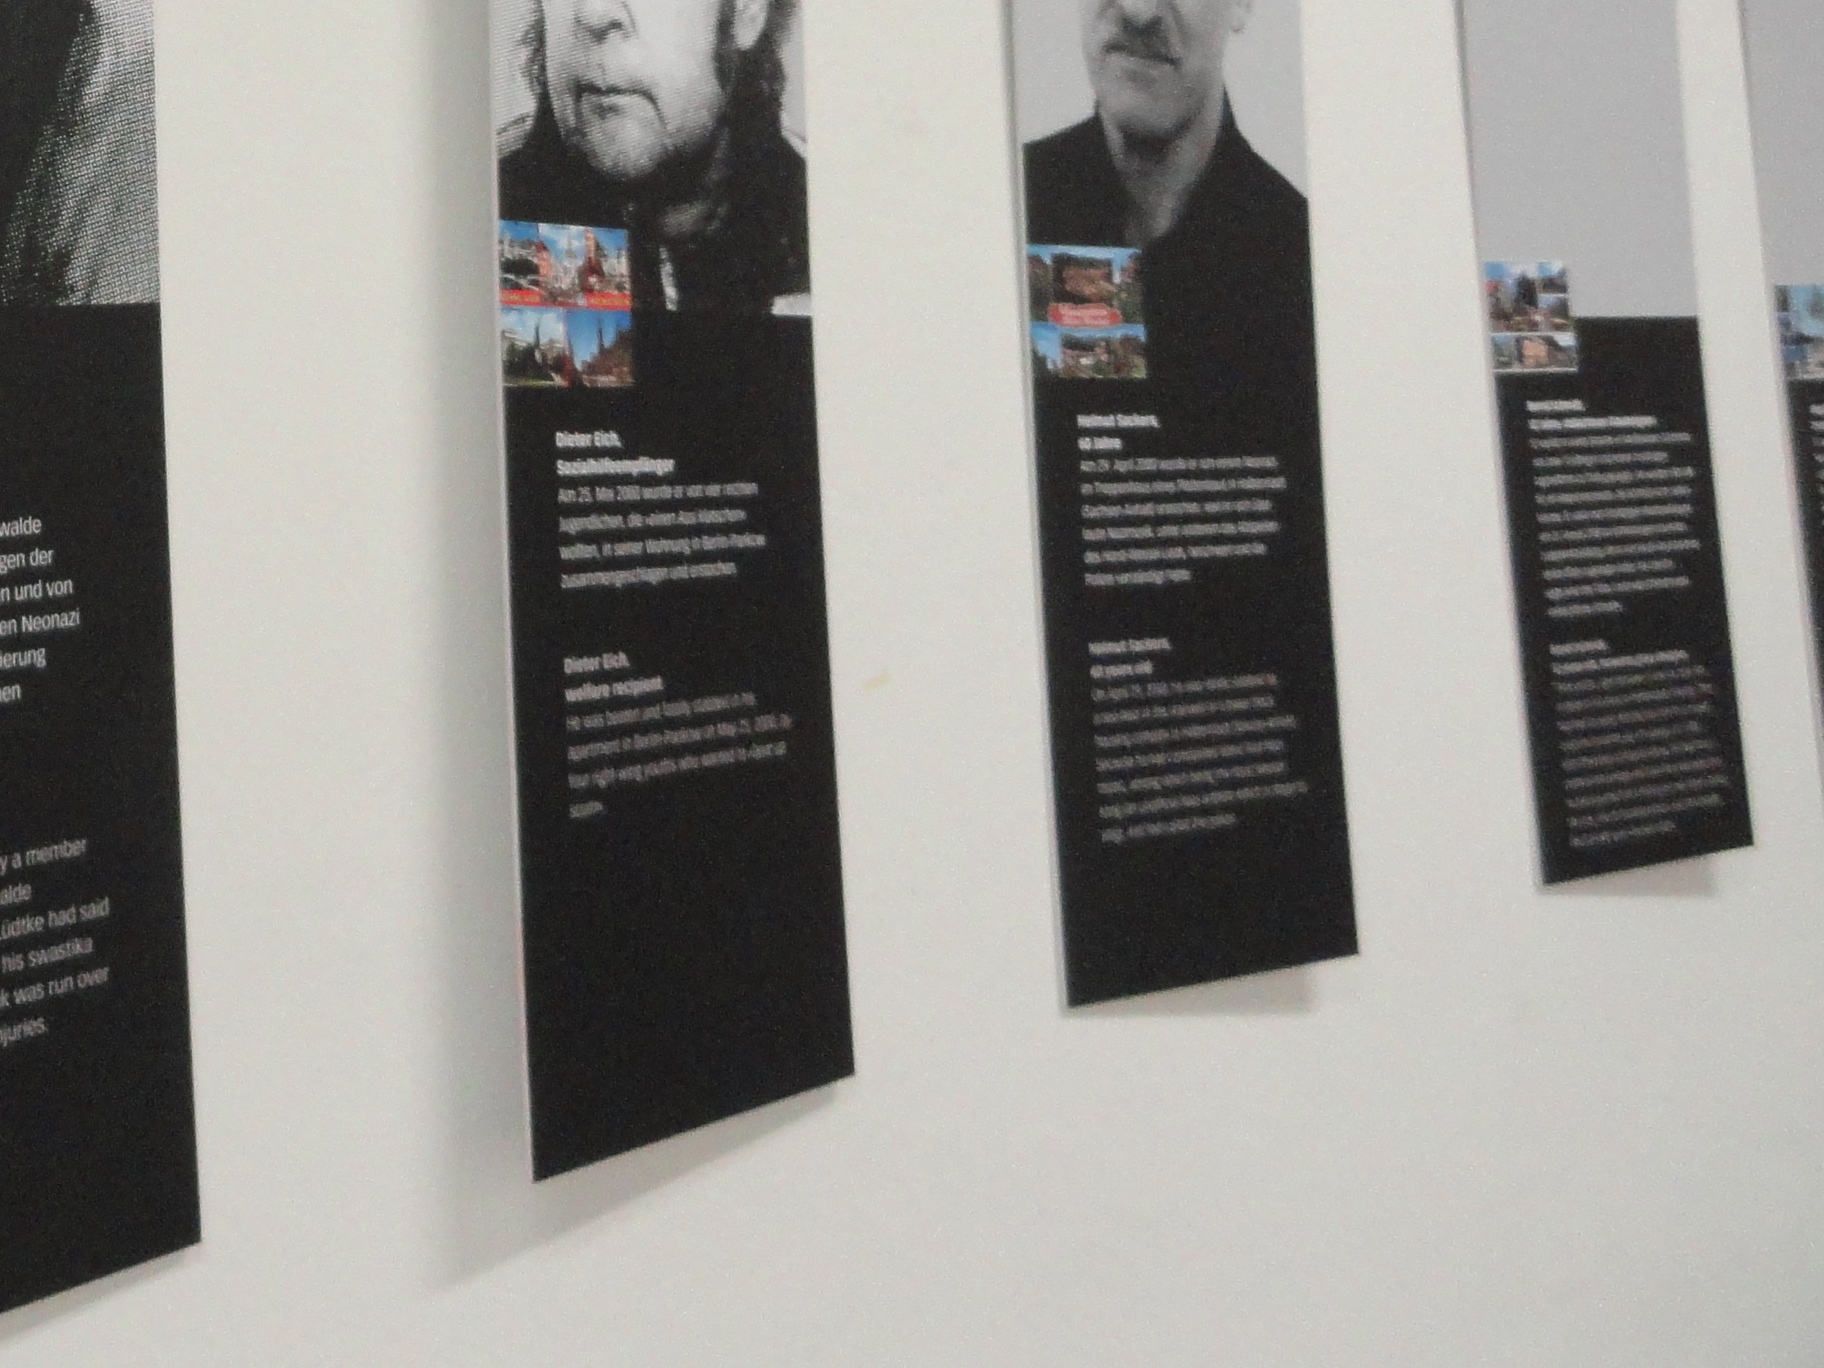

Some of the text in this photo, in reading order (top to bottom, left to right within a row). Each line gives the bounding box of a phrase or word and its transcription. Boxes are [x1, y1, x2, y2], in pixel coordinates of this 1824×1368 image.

[28, 547, 54, 567] der
[13, 579, 44, 602] und
[45, 579, 74, 598] von
[20, 610, 81, 633] Neonazi
